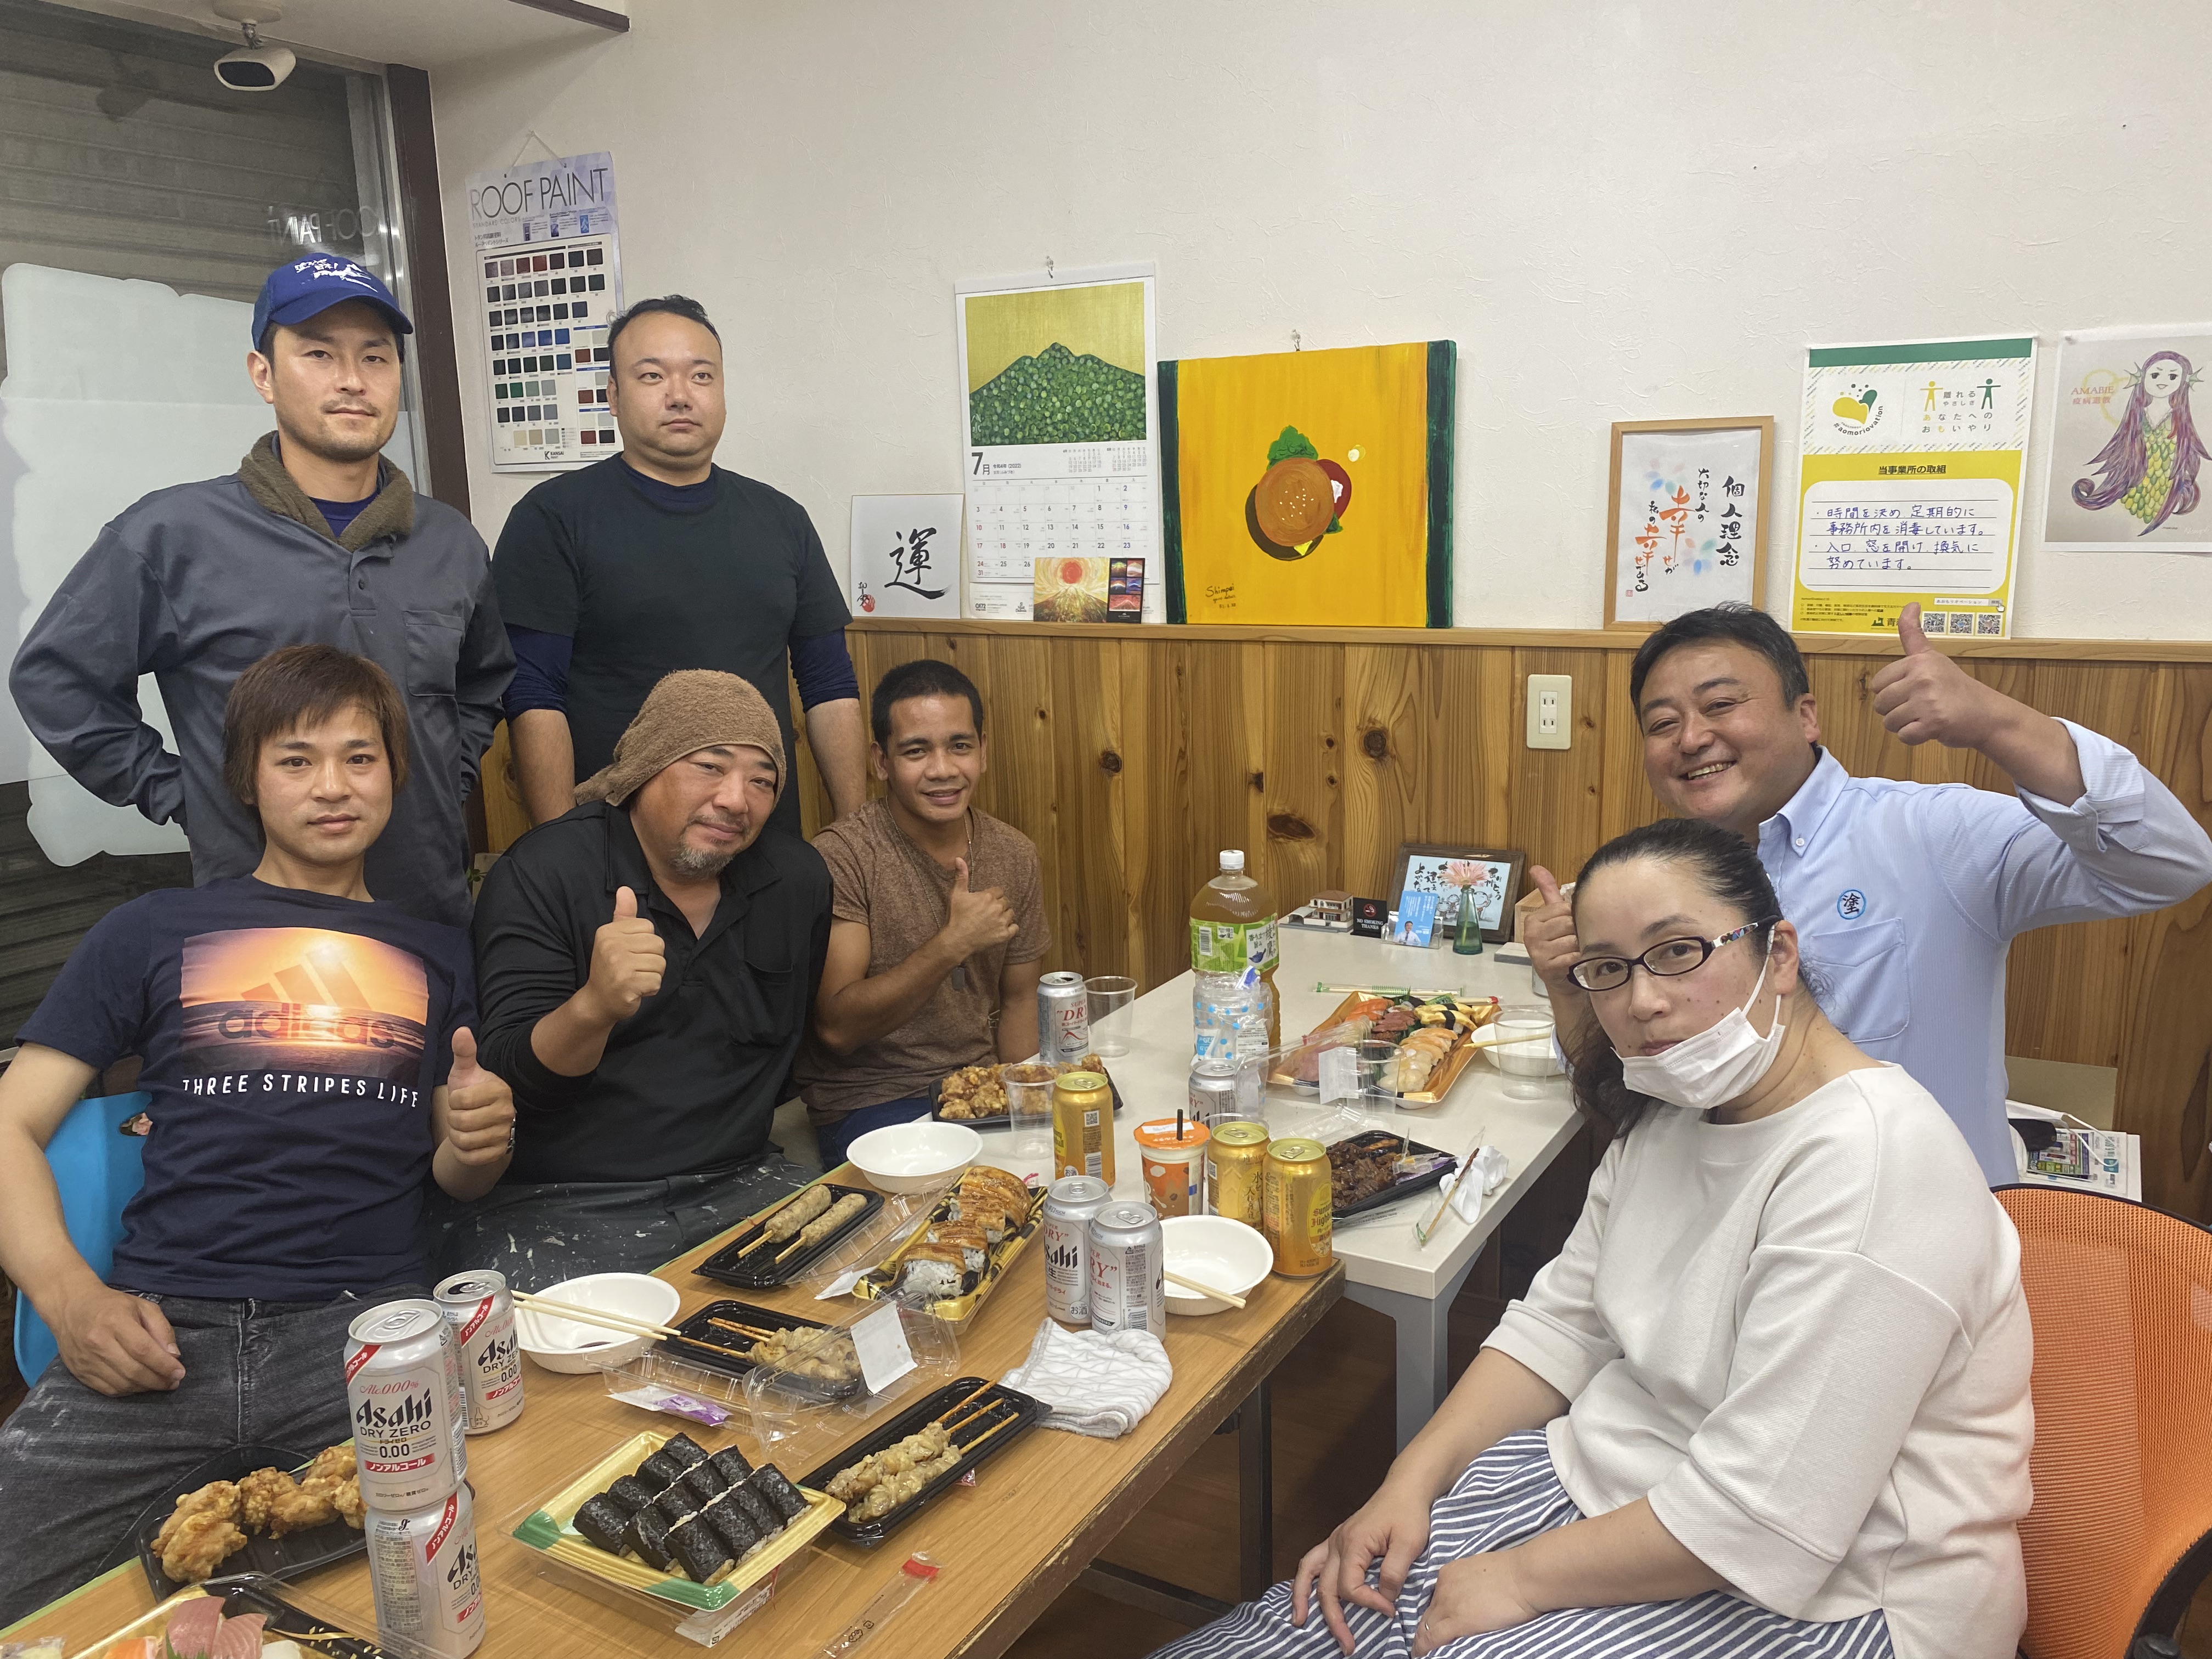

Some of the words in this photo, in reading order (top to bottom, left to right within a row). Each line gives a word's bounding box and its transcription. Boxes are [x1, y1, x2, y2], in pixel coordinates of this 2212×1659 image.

[470, 179, 533, 221] ROOF
[539, 167, 608, 210] PAINT
[2070, 386, 2114, 395] AMABIE
[1833, 405, 1883, 436] #aomoriovation
[1923, 412, 1993, 421] あなたへの
[1922, 424, 1991, 433] おもいやり
[1878, 465, 1946, 474] 当事業所の取組
[1716, 475, 1745, 566] 個人理念
[884, 527, 952, 600] 運
[1842, 893, 1860, 915] 塗
[183, 1074, 249, 1096] THREE
[263, 1074, 366, 1096] STRIPES
[377, 1082, 419, 1108] LIFE
[1045, 1244, 1078, 1269] sahi
[1048, 1266, 1057, 1279] 生
[1070, 1305, 1087, 1315] お酒
[464, 1304, 488, 1337] ノンアルコール
[483, 1359, 504, 1374] DRY
[501, 1364, 517, 1383] 0.00
[356, 1387, 433, 1428] Asahi
[360, 1426, 384, 1438] DRY
[389, 1420, 431, 1438] ZERO
[379, 1443, 410, 1458] 0.00
[370, 1458, 426, 1472] ノンアルコール
[431, 1504, 455, 1550] ノンアルコール
[453, 1567, 473, 1590] DRY
